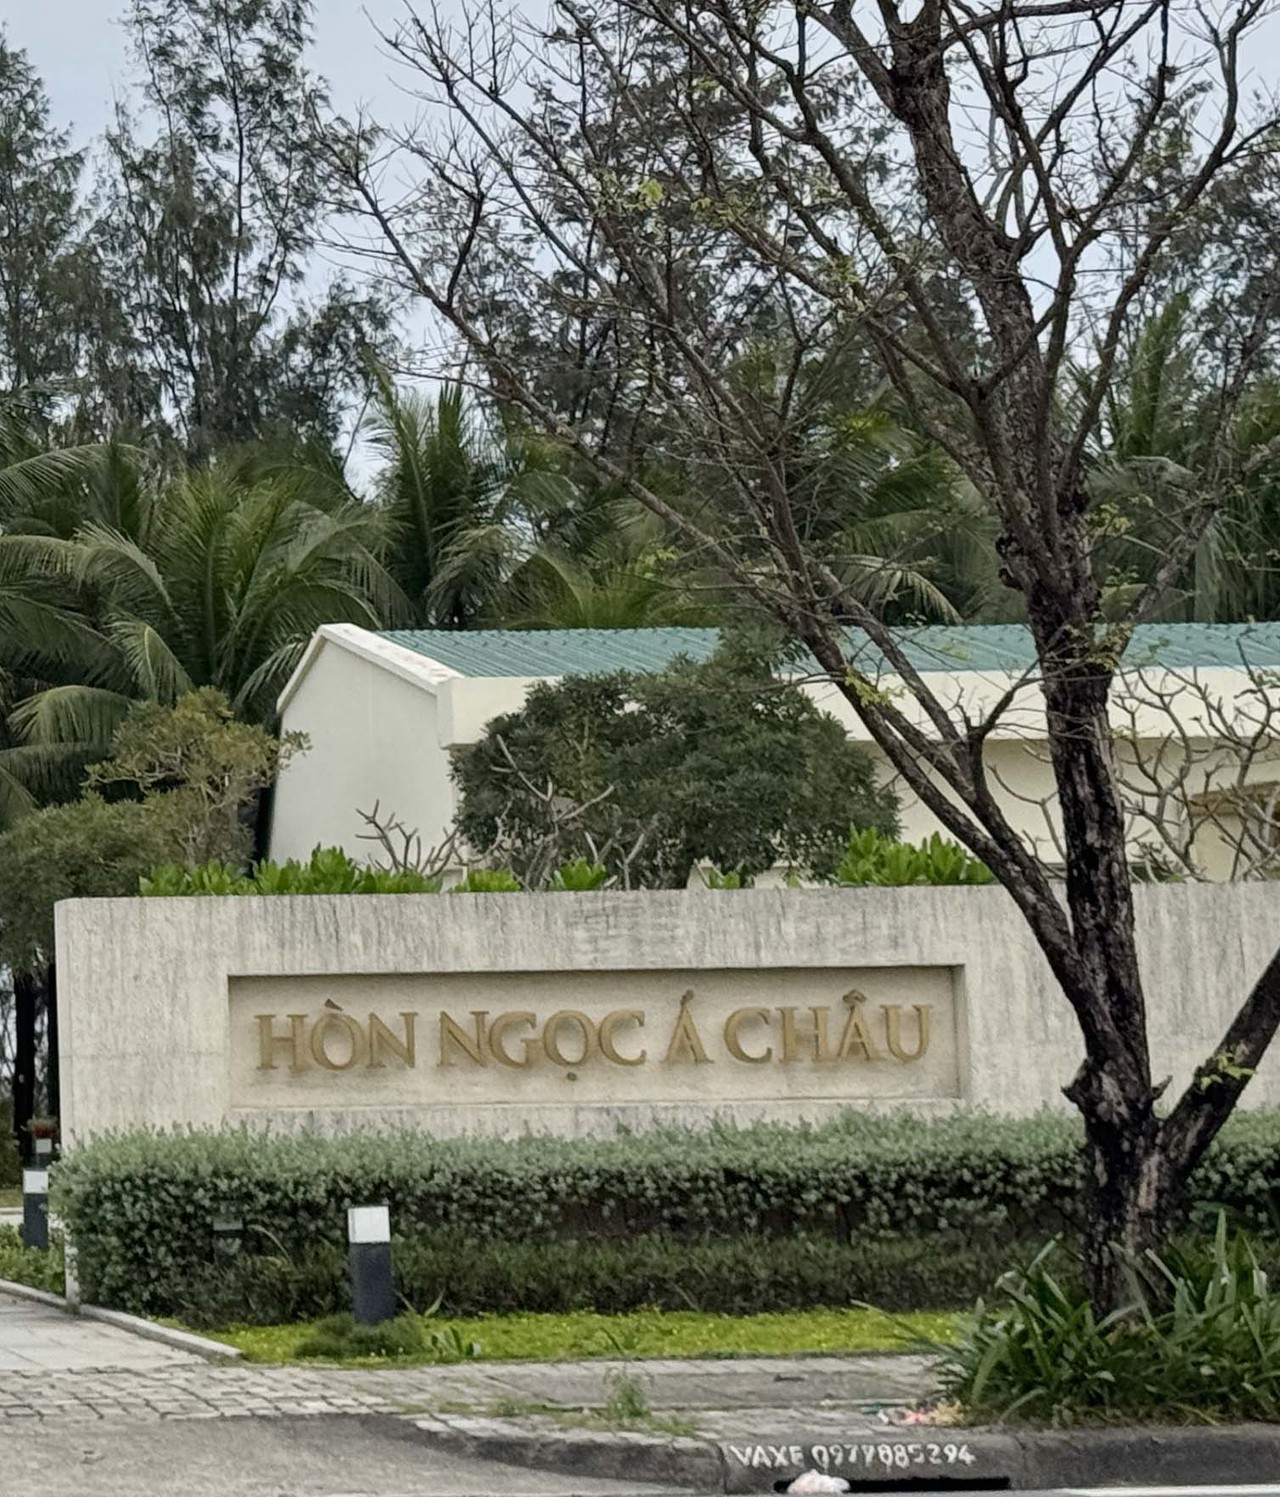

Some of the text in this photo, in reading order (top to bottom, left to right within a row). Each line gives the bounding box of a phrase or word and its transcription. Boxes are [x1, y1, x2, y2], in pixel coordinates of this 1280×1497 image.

[256, 989, 933, 1081] HÒN NGỌC Á CHÂU
